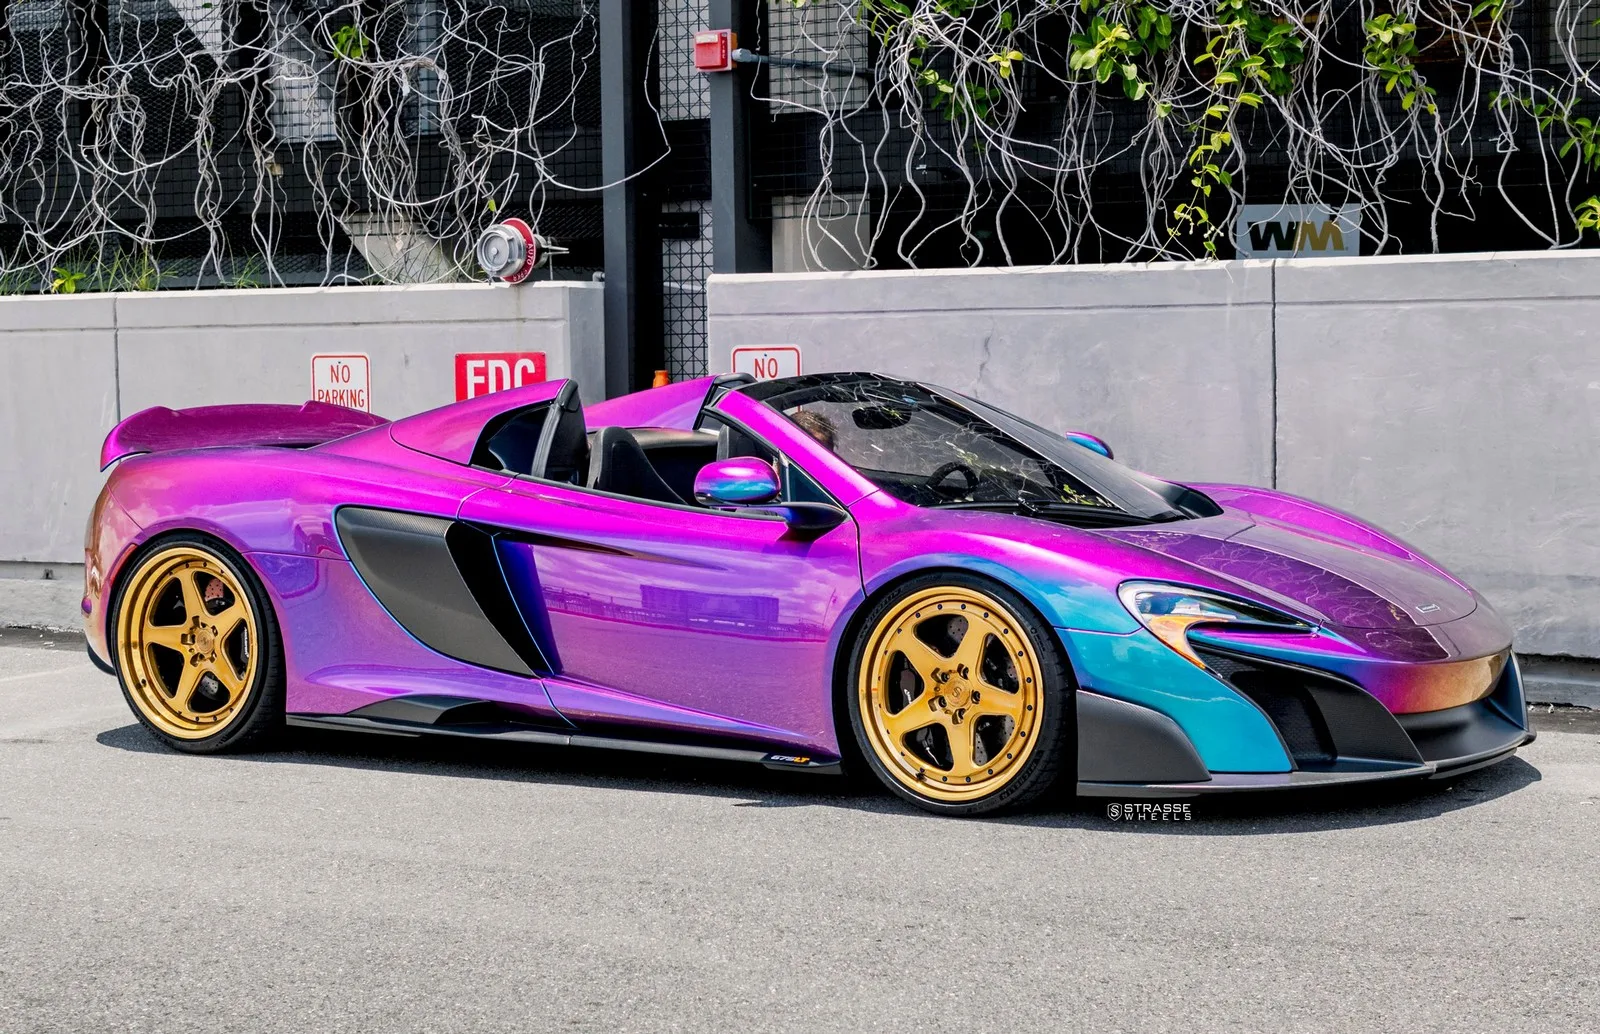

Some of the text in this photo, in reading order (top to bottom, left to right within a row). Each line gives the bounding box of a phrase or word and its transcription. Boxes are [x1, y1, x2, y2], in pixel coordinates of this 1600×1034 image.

[1247, 220, 1344, 251] WM
[526, 243, 534, 266] AUTO
[330, 364, 351, 384] NO
[466, 358, 536, 400] FDC
[754, 357, 778, 379] NO
[317, 389, 365, 408] PARKING
